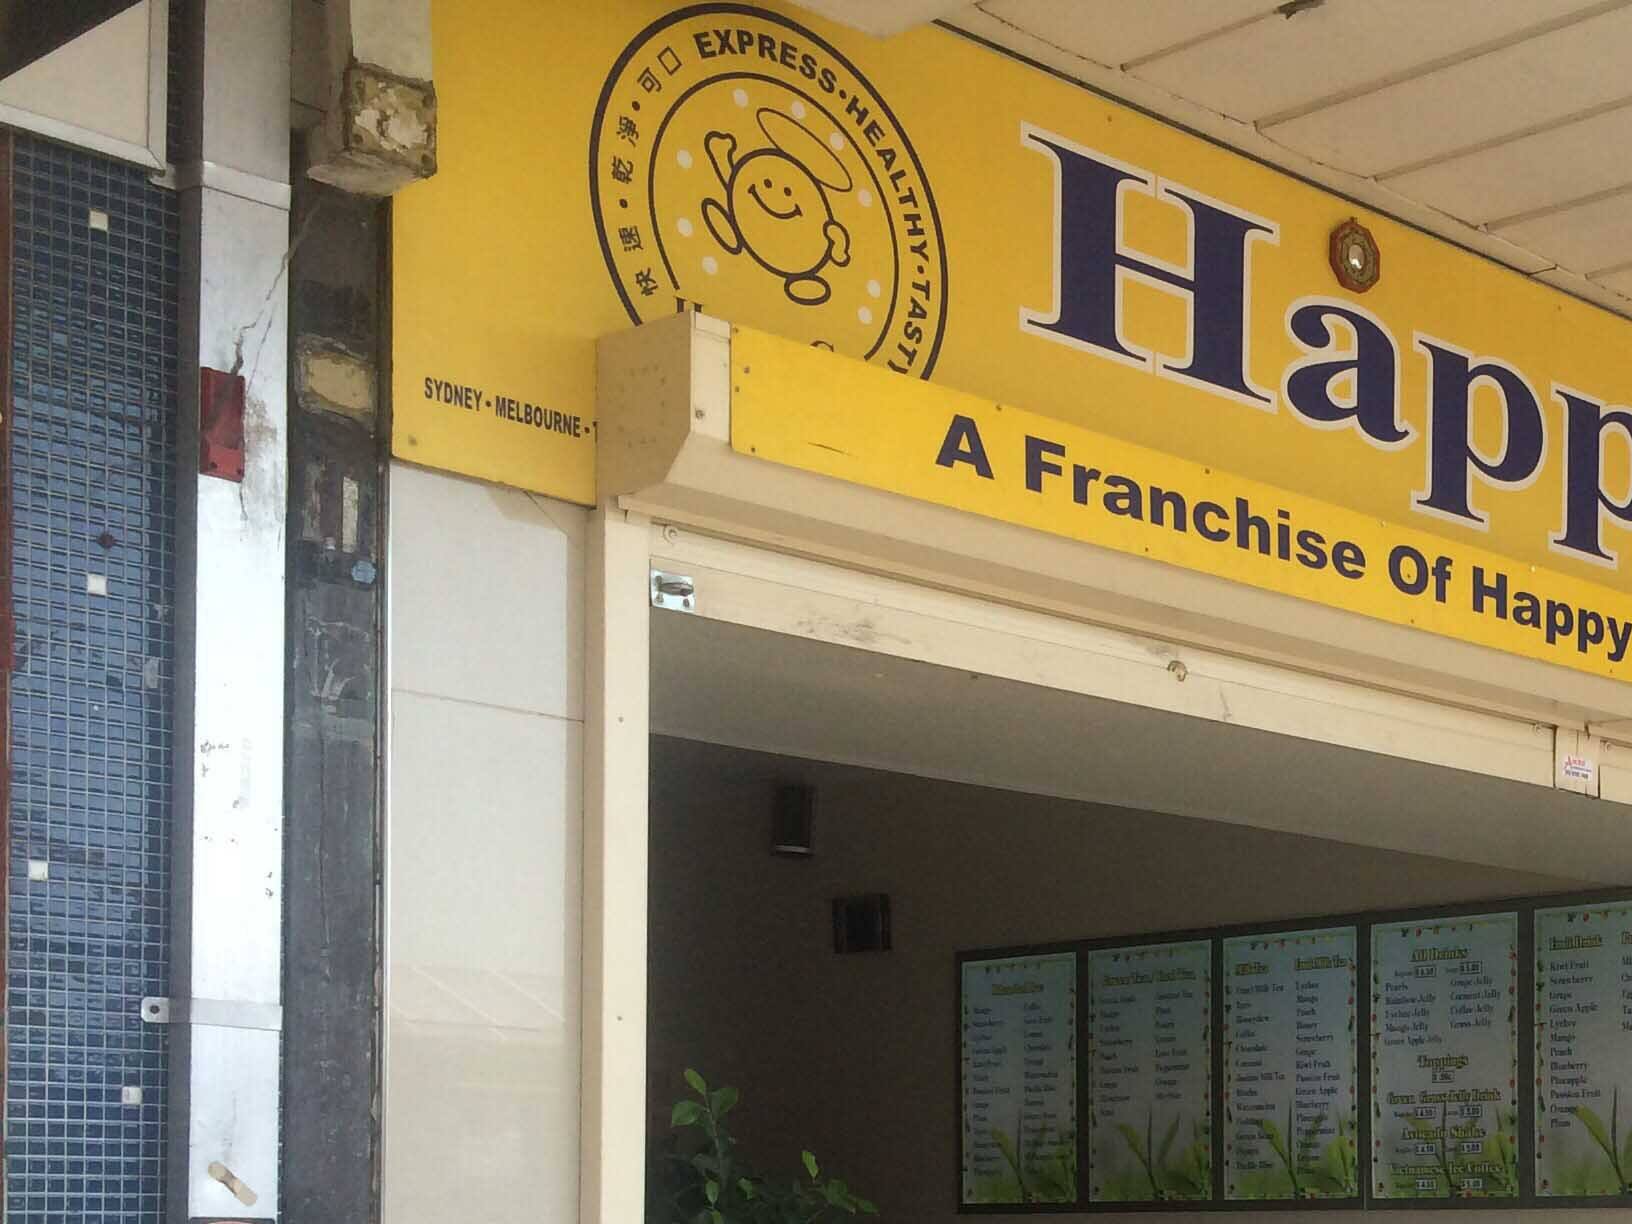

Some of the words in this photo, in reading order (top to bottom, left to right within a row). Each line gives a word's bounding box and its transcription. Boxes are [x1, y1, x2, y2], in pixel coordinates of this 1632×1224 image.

[694, 29, 839, 93] EXPRESS
[844, 95, 930, 264] HEALTHY
[424, 376, 483, 412] SYDNEY
[495, 395, 581, 438] MELBOURNE
[935, 413, 995, 480] A
[1024, 435, 1367, 581] Franchise
[1387, 544, 1454, 604] Of
